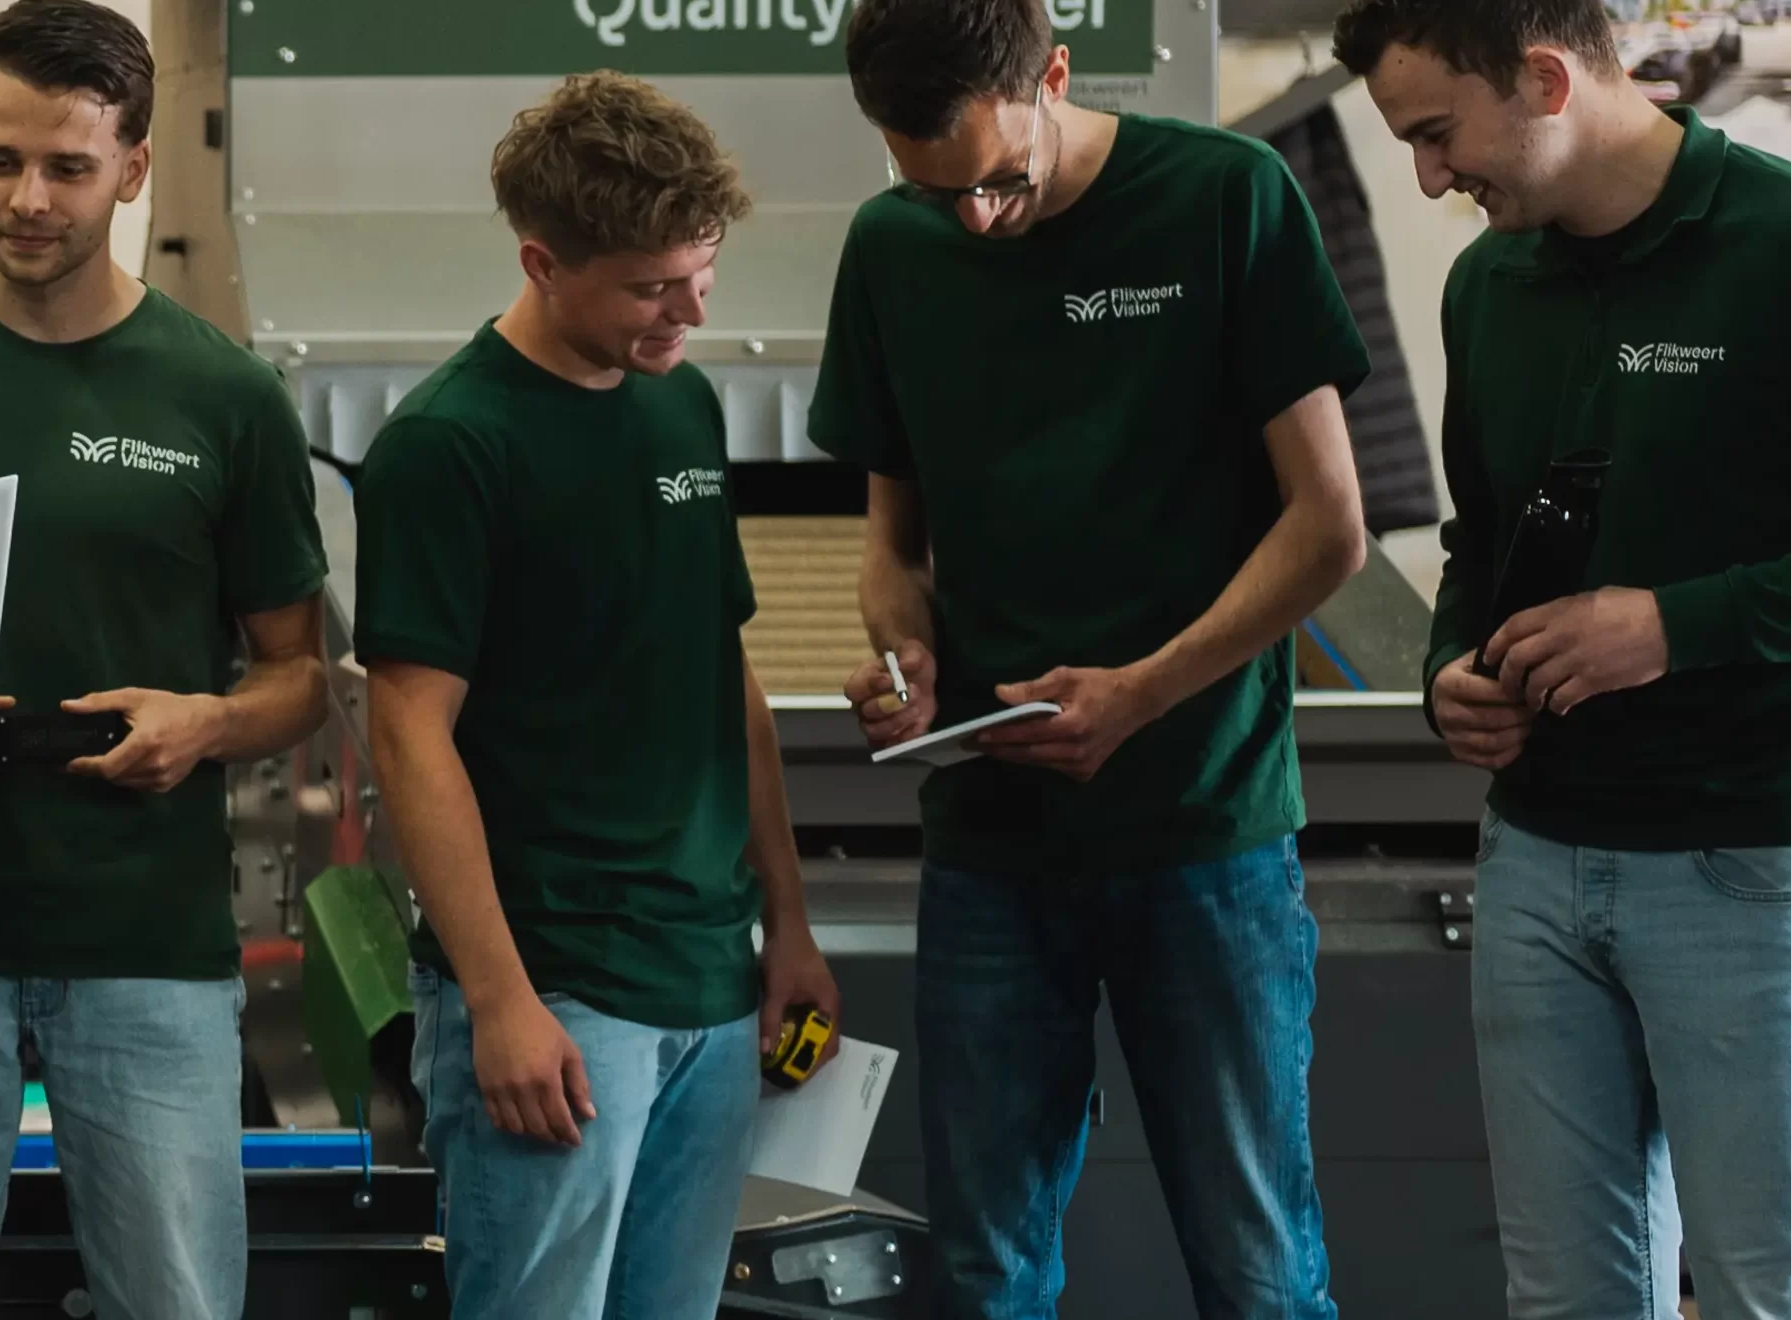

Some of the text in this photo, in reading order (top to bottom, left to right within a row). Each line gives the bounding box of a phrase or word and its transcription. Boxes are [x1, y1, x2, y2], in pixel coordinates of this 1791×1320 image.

[1111, 282, 1184, 302] Flikweert
[1112, 300, 1161, 318] Vision
[1656, 342, 1726, 361] Flikweert
[1654, 357, 1699, 374] Vision
[121, 437, 200, 469] Flikweert
[121, 452, 175, 476] Vision
